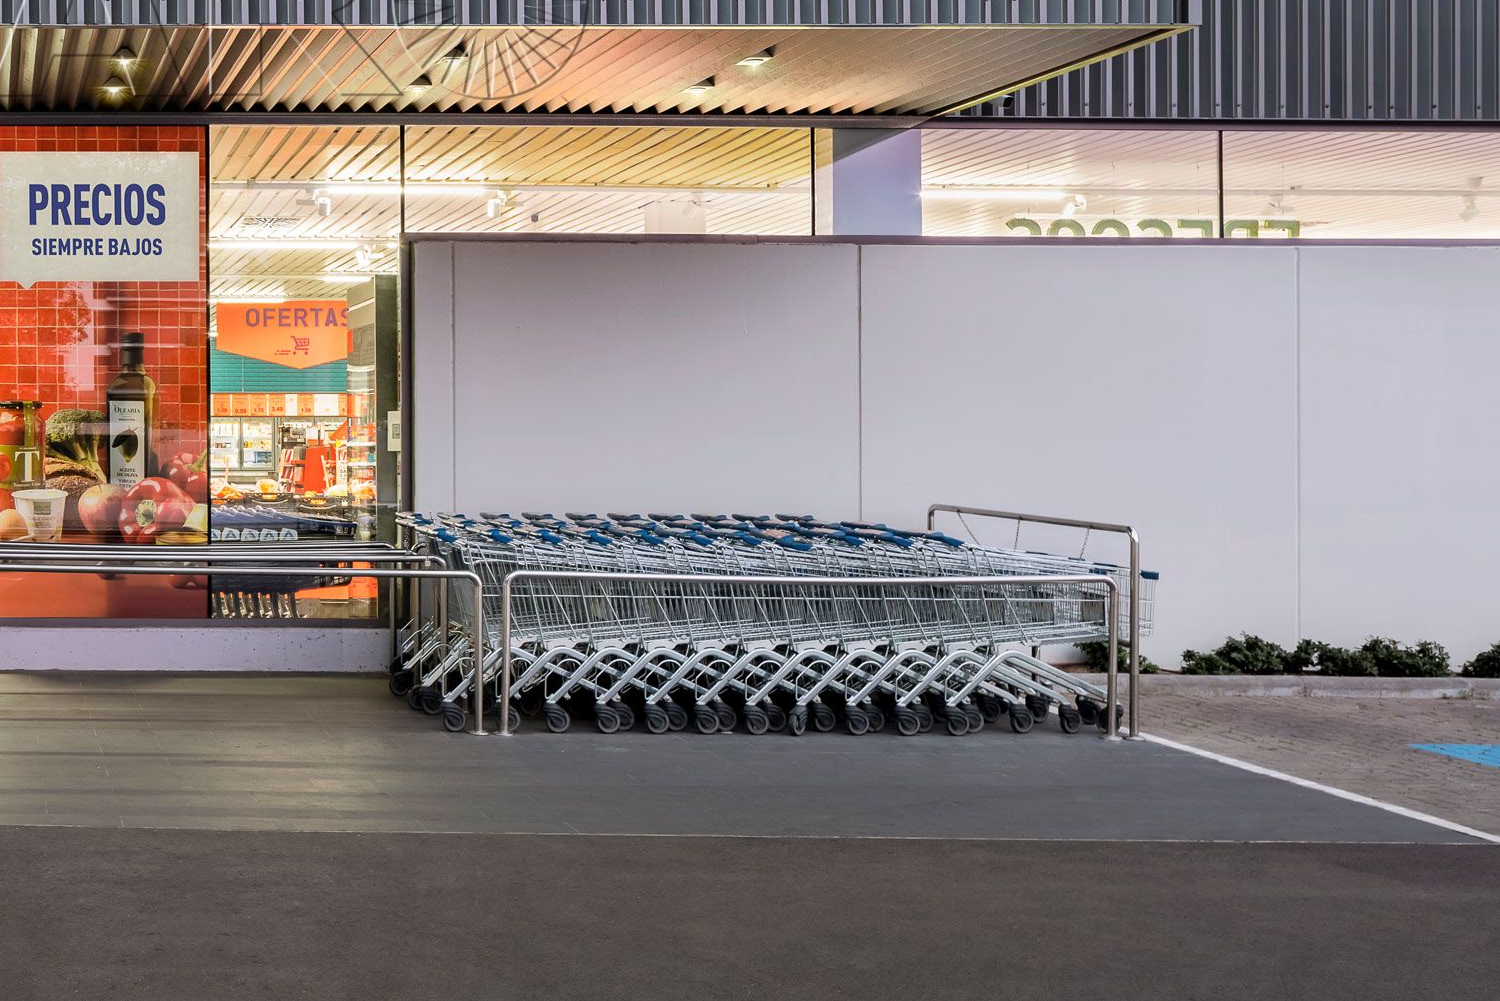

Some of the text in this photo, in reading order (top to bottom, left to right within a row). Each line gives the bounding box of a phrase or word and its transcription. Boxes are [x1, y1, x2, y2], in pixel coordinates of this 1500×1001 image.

[28, 183, 166, 226] PRECIOS
[31, 237, 163, 256] SIEMPRE BAJOS
[245, 307, 348, 328] OFERTAS
